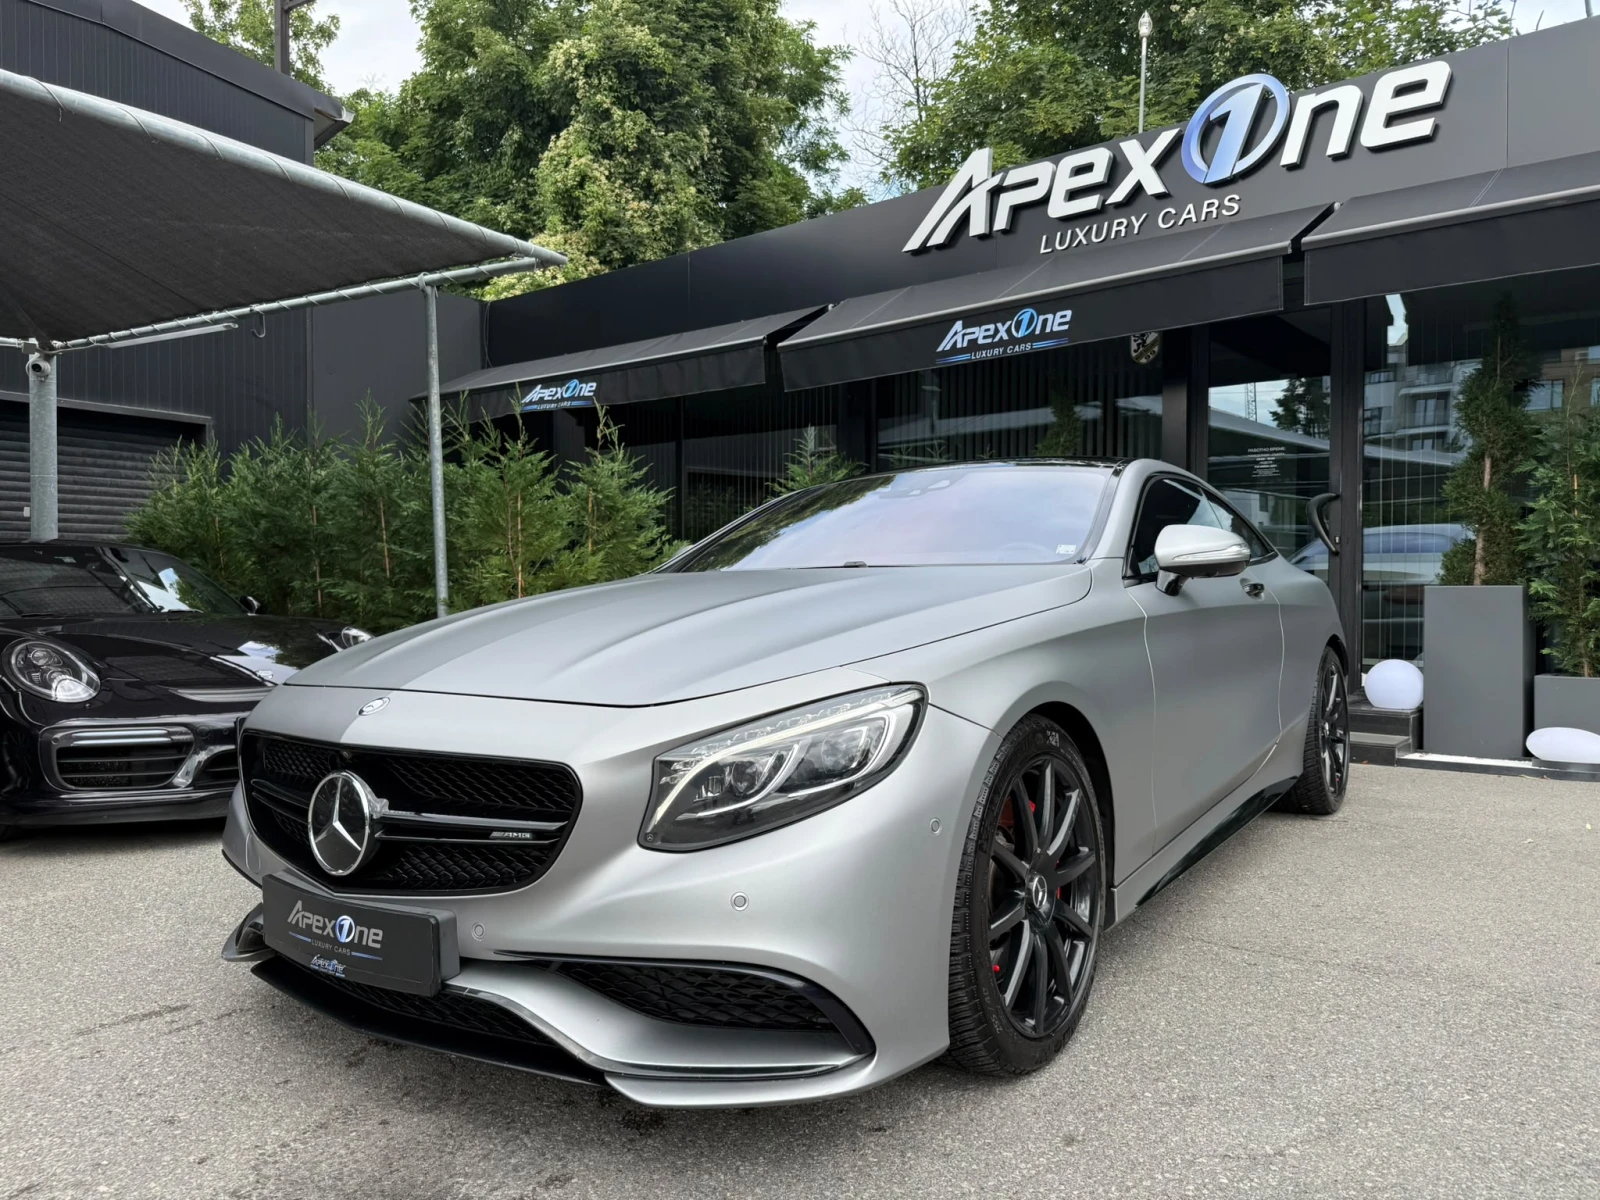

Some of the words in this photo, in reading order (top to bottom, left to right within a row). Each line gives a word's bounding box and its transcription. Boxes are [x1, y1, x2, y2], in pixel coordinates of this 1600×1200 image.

[1040, 212, 1148, 255] LUXURY
[1158, 194, 1242, 229] CARS
[971, 347, 1004, 360] LUXURY
[1006, 342, 1032, 354] CARS
[311, 939, 333, 951] LUXURY
[334, 945, 351, 956] CARS
